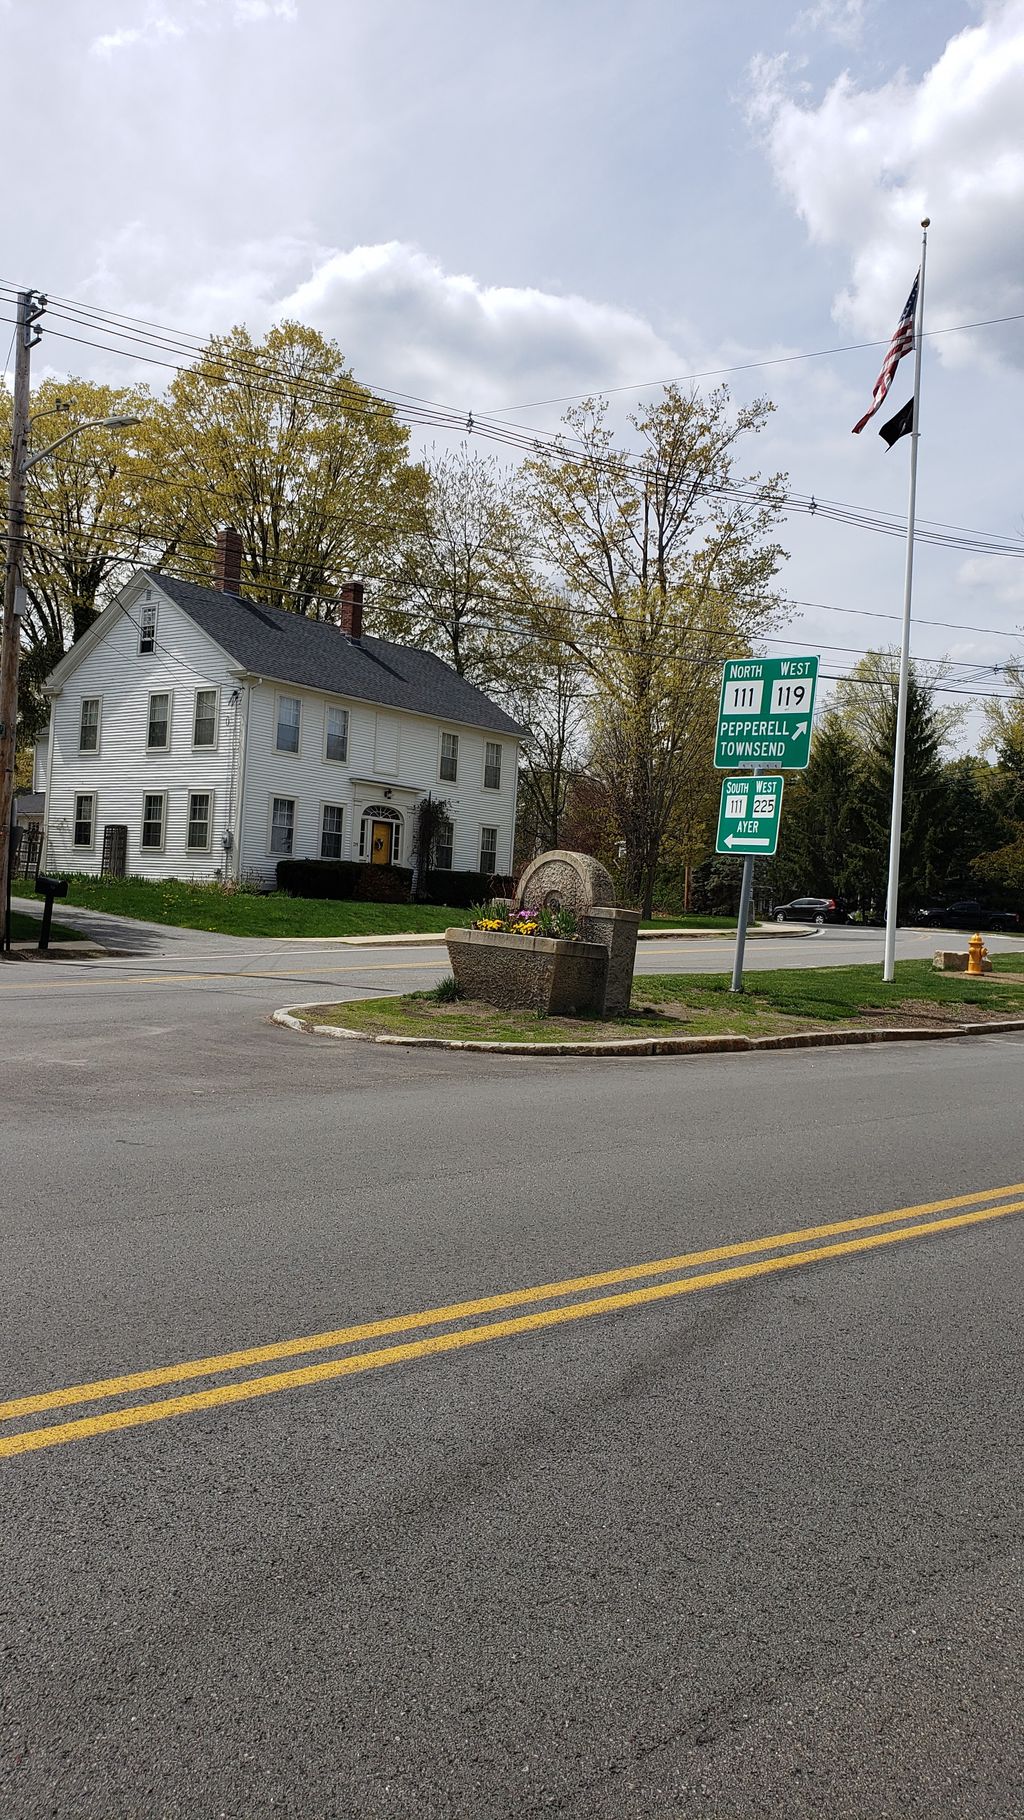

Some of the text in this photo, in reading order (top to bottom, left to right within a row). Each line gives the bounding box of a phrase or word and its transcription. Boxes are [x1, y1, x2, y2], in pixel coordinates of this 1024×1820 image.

[734, 685, 806, 707] 111 119
[720, 721, 790, 736] PEPPERELL
[720, 742, 786, 756] TOWNSEND
[731, 799, 774, 814] 111 225
[736, 820, 759, 833] AYER
